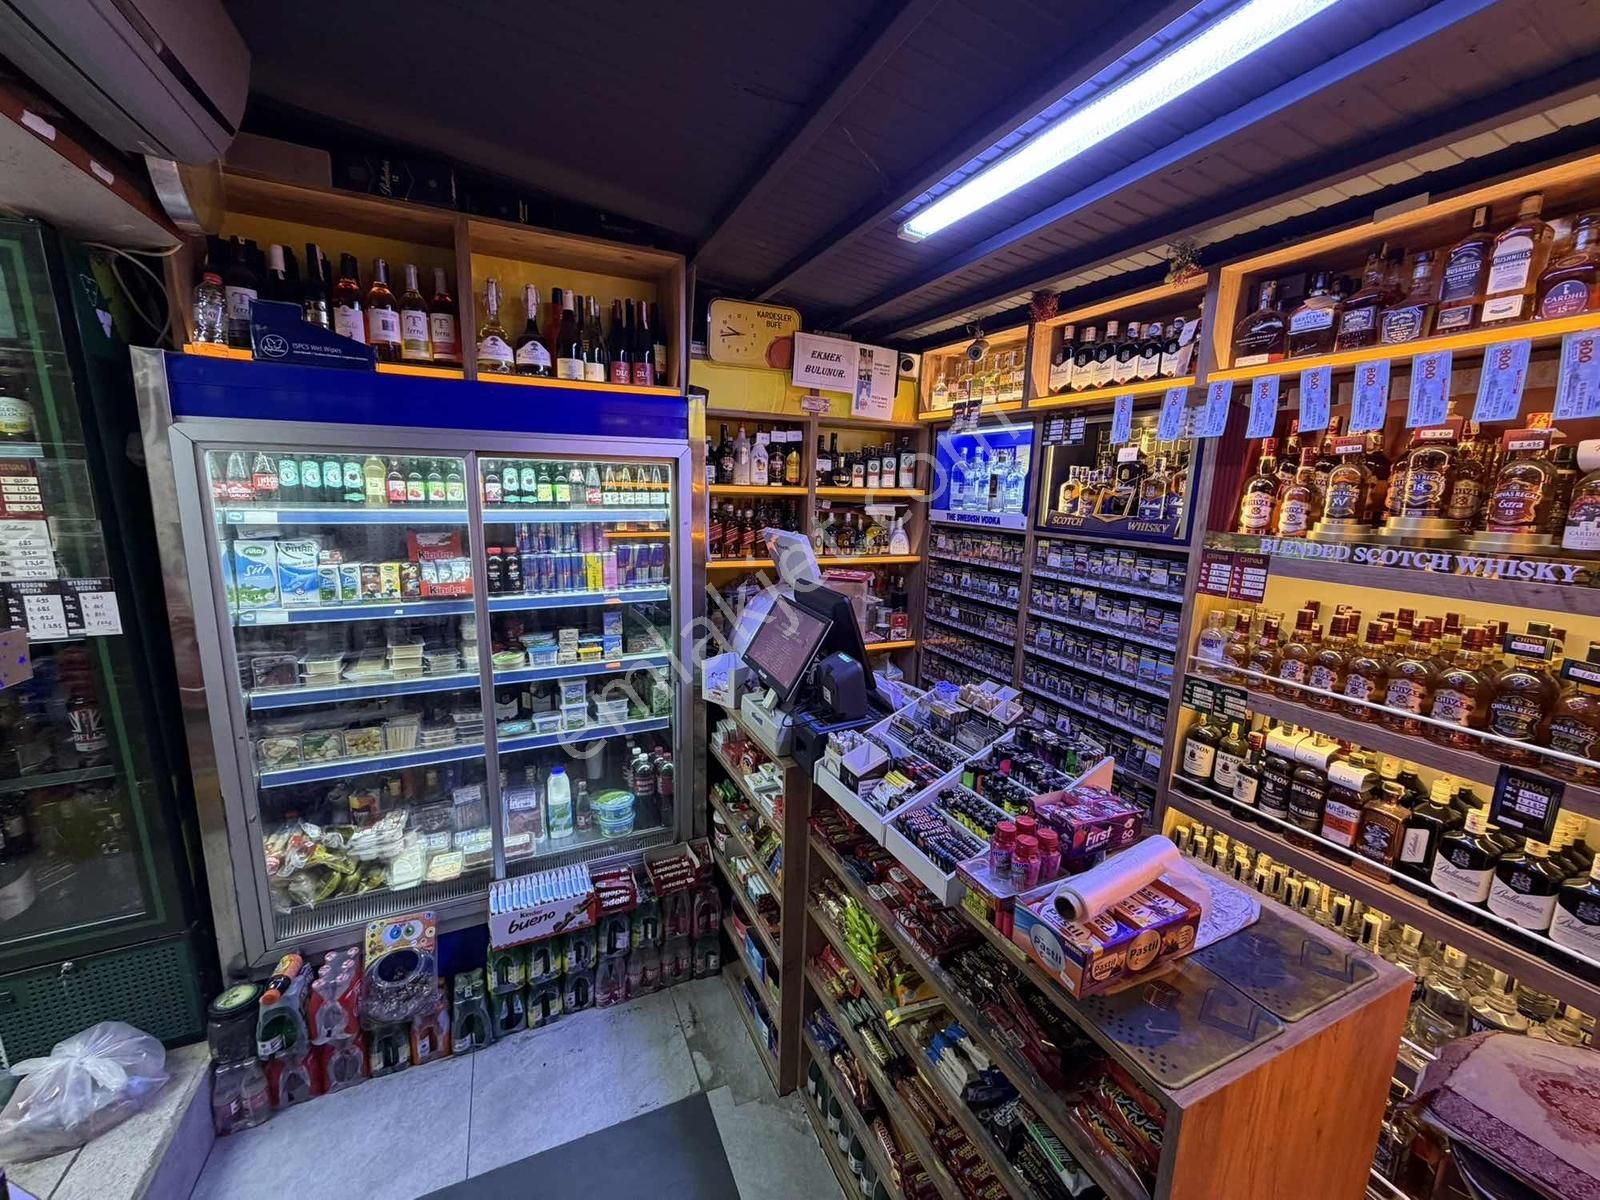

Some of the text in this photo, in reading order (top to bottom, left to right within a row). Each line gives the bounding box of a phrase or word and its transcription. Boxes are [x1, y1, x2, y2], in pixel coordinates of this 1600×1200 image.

[1493, 250, 1532, 265] BUSHMILLS
[811, 350, 842, 363] EKMEK
[1499, 346, 1512, 370] 800
[1578, 338, 1594, 363] 800
[804, 364, 847, 379] BULUNUR.
[1366, 367, 1376, 387] 800
[1425, 358, 1436, 380] 800
[1412, 482, 1425, 491] 18
[1498, 500, 1524, 509] Extra
[946, 512, 1001, 525] THE SWEDISH VODKA
[1051, 515, 1170, 533] SCOTCH WHISKY
[1260, 538, 1585, 583] BLENDED SCOTCH WHISKY
[1435, 695, 1467, 708] CHIVAS
[1508, 777, 1552, 795] CHIVAS
[1085, 825, 1113, 847] First
[1121, 829, 1134, 840] 60
[1493, 885, 1544, 914] Ballantine's
[508, 911, 556, 935] bueno
